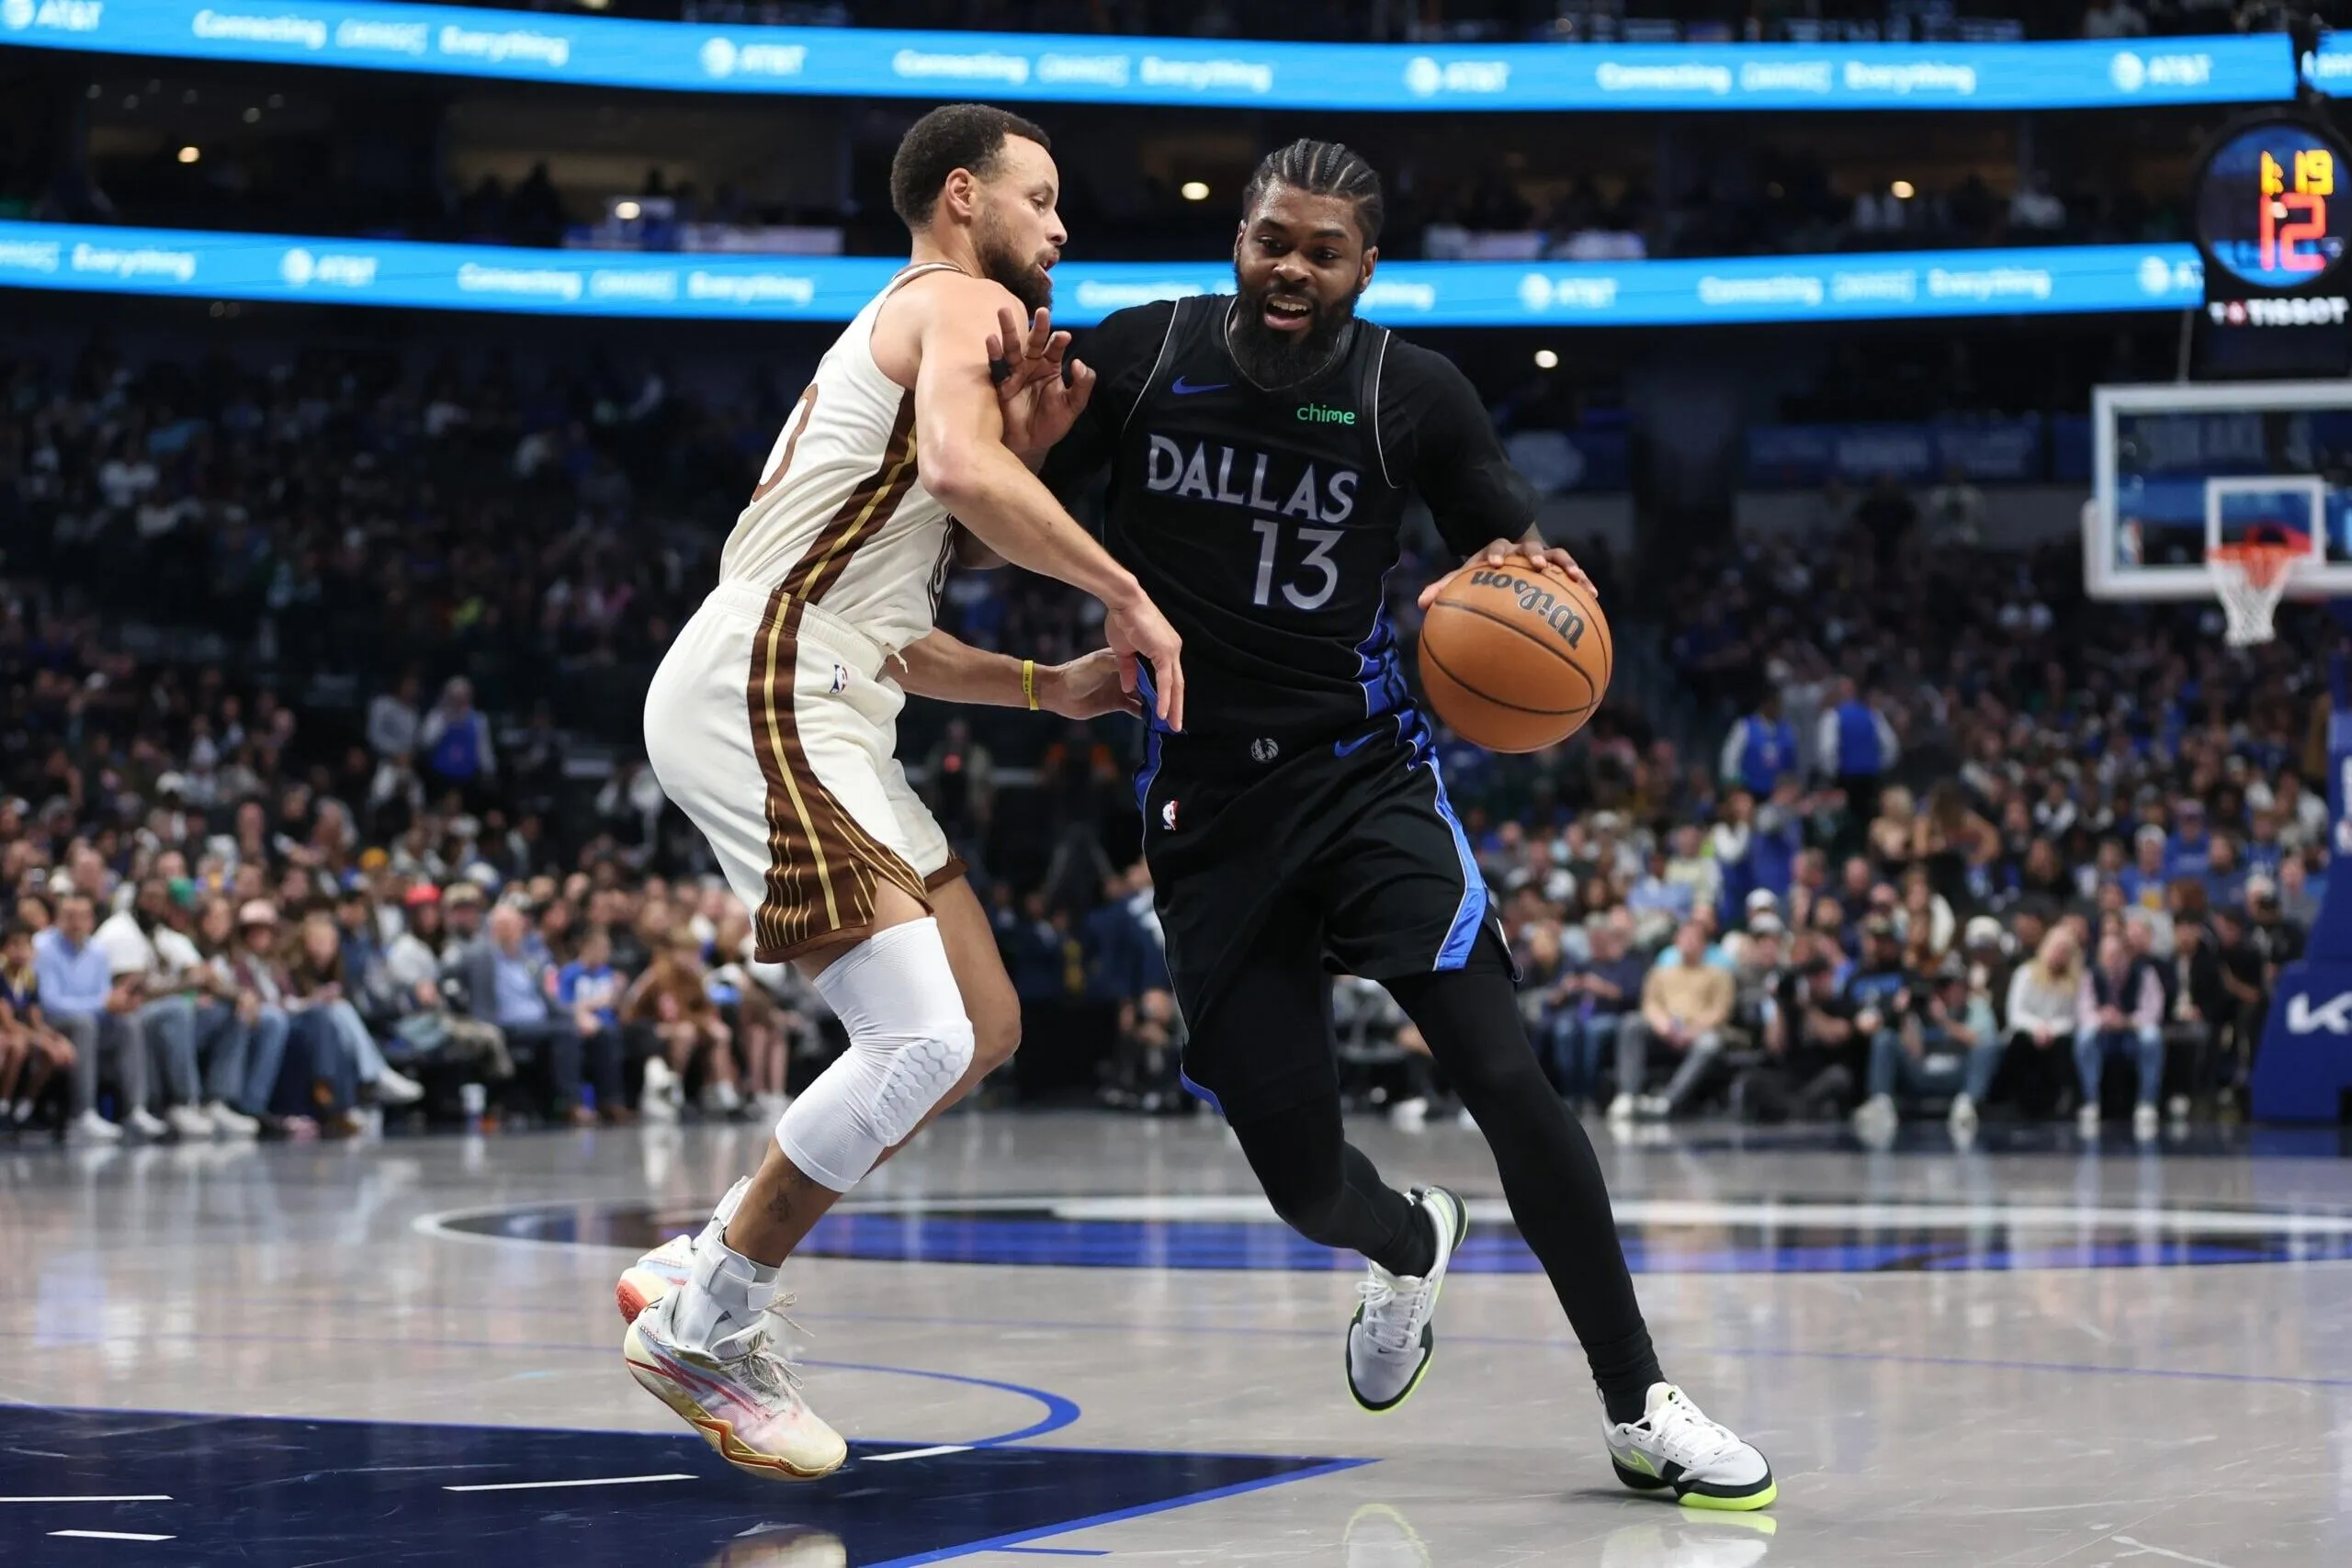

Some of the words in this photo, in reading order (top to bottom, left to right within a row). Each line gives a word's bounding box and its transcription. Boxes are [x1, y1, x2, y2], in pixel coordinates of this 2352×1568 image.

[2260, 149, 2335, 196] 1:19
[2259, 193, 2327, 272] 12
[1296, 402, 1355, 425] chime
[1147, 434, 1359, 524] DALLAS
[1252, 518, 1345, 610] 13
[1470, 570, 1586, 650] Wilson
